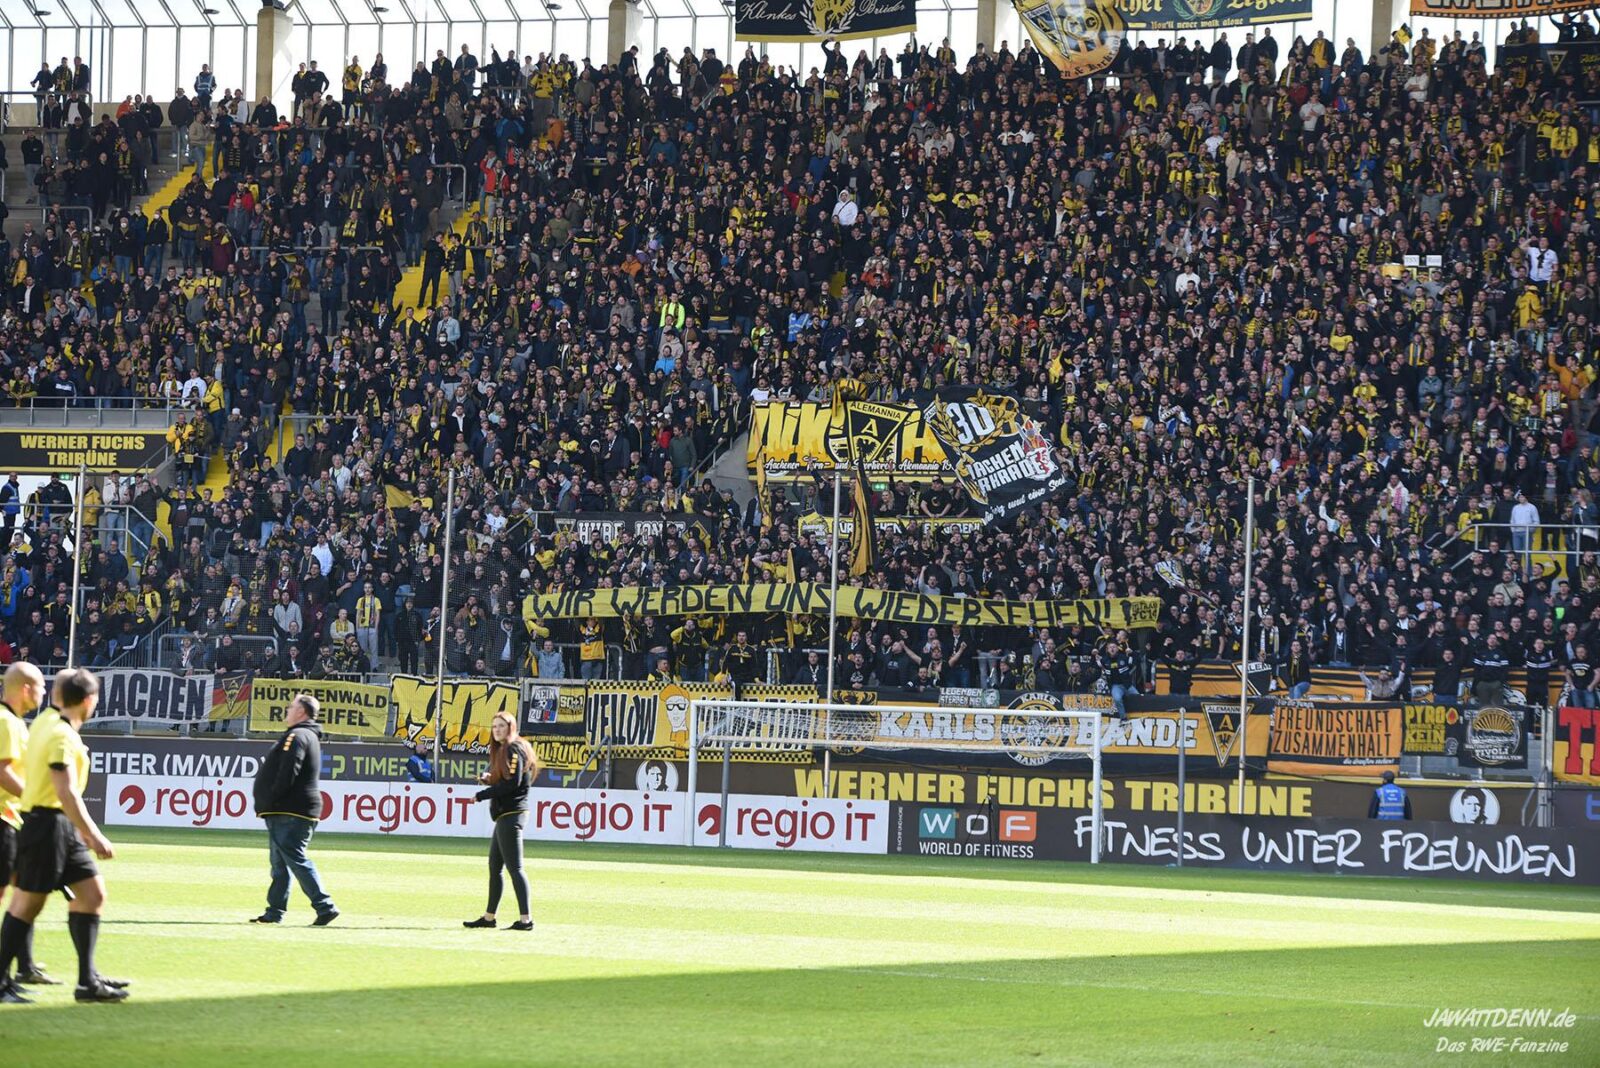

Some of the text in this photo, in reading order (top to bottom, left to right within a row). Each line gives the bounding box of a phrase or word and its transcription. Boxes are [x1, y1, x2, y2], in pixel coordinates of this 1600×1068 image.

[850, 402, 901, 420] ALEMANNIA
[20, 435, 146, 450] WERNER FUCHS
[47, 450, 118, 466] TRIBÜNE
[764, 457, 800, 472] Aachener
[898, 456, 940, 472] Alemannia
[532, 588, 596, 619] WIR
[611, 583, 753, 616] WERDEN
[764, 582, 841, 614] UNS
[91, 672, 207, 721] AACHEN
[940, 687, 983, 696] LEGENDEN
[1020, 692, 1058, 706] KARLS
[1064, 695, 1113, 709] ULTRAS
[587, 693, 659, 747] YELLOW
[1207, 705, 1242, 714] ALEMANN
[1278, 708, 1390, 734] FREUNDSCHAFT
[1405, 705, 1446, 725] PYRO
[879, 710, 1199, 750] KARLS BANDE
[1405, 728, 1446, 744] KEIN
[1273, 730, 1392, 757] ZUSAMMENHALT
[352, 756, 490, 779] TIMEPTNER
[156, 779, 247, 826] regio
[793, 768, 1313, 818] WERNER FUCHS TRIBÜNE
[343, 785, 437, 832] regio
[536, 791, 634, 840] regio
[736, 799, 836, 848] regio
[919, 841, 1035, 859] WORLD OF FITNESS
[1073, 815, 1577, 879] FTNESS UNTER FREUNDEN
